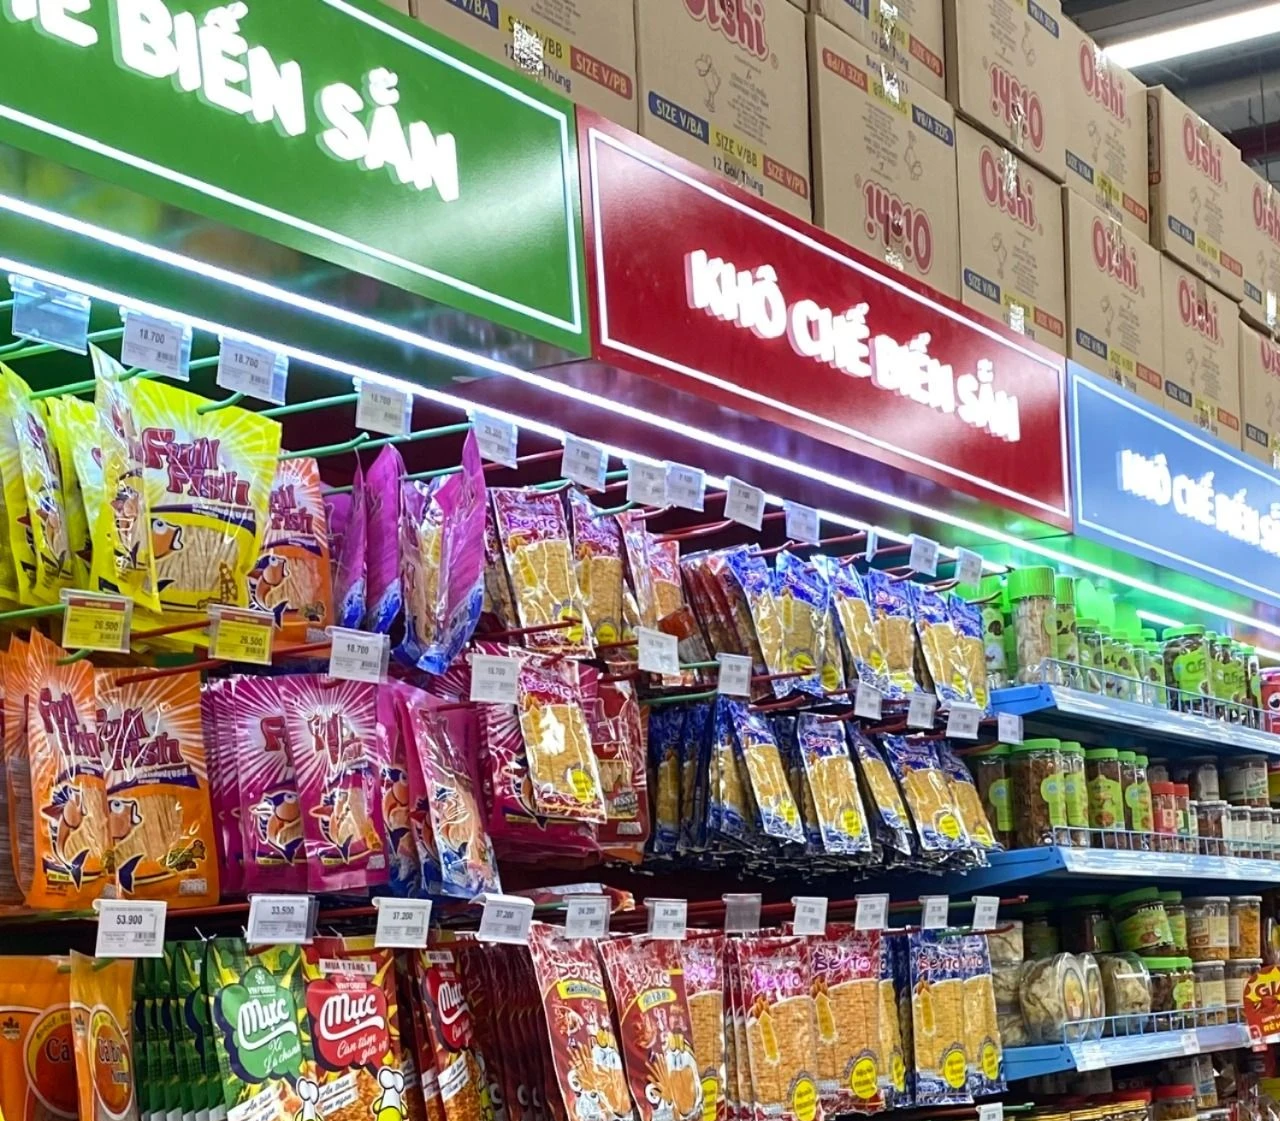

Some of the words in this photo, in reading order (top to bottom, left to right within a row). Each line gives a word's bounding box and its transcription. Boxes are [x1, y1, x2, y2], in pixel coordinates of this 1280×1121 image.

[575, 57, 601, 80] SIZE
[601, 69, 629, 96] V/PB
[316, 67, 460, 202] SẴN
[656, 100, 679, 123] SIZE
[680, 111, 703, 137] V/BA
[715, 132, 734, 156] SIZE
[735, 140, 758, 168] V/BB
[139, 328, 165, 345] 18.700
[685, 249, 787, 339] KHÔ
[787, 302, 872, 377] CHẾ
[868, 331, 955, 413] BIẾN
[957, 358, 1020, 442] SẴN
[233, 353, 259, 369] 18.700
[346, 643, 369, 655] 18.700
[116, 914, 143, 925] 53.900
[324, 961, 341, 970] MUA
[320, 993, 385, 1041] Mực
